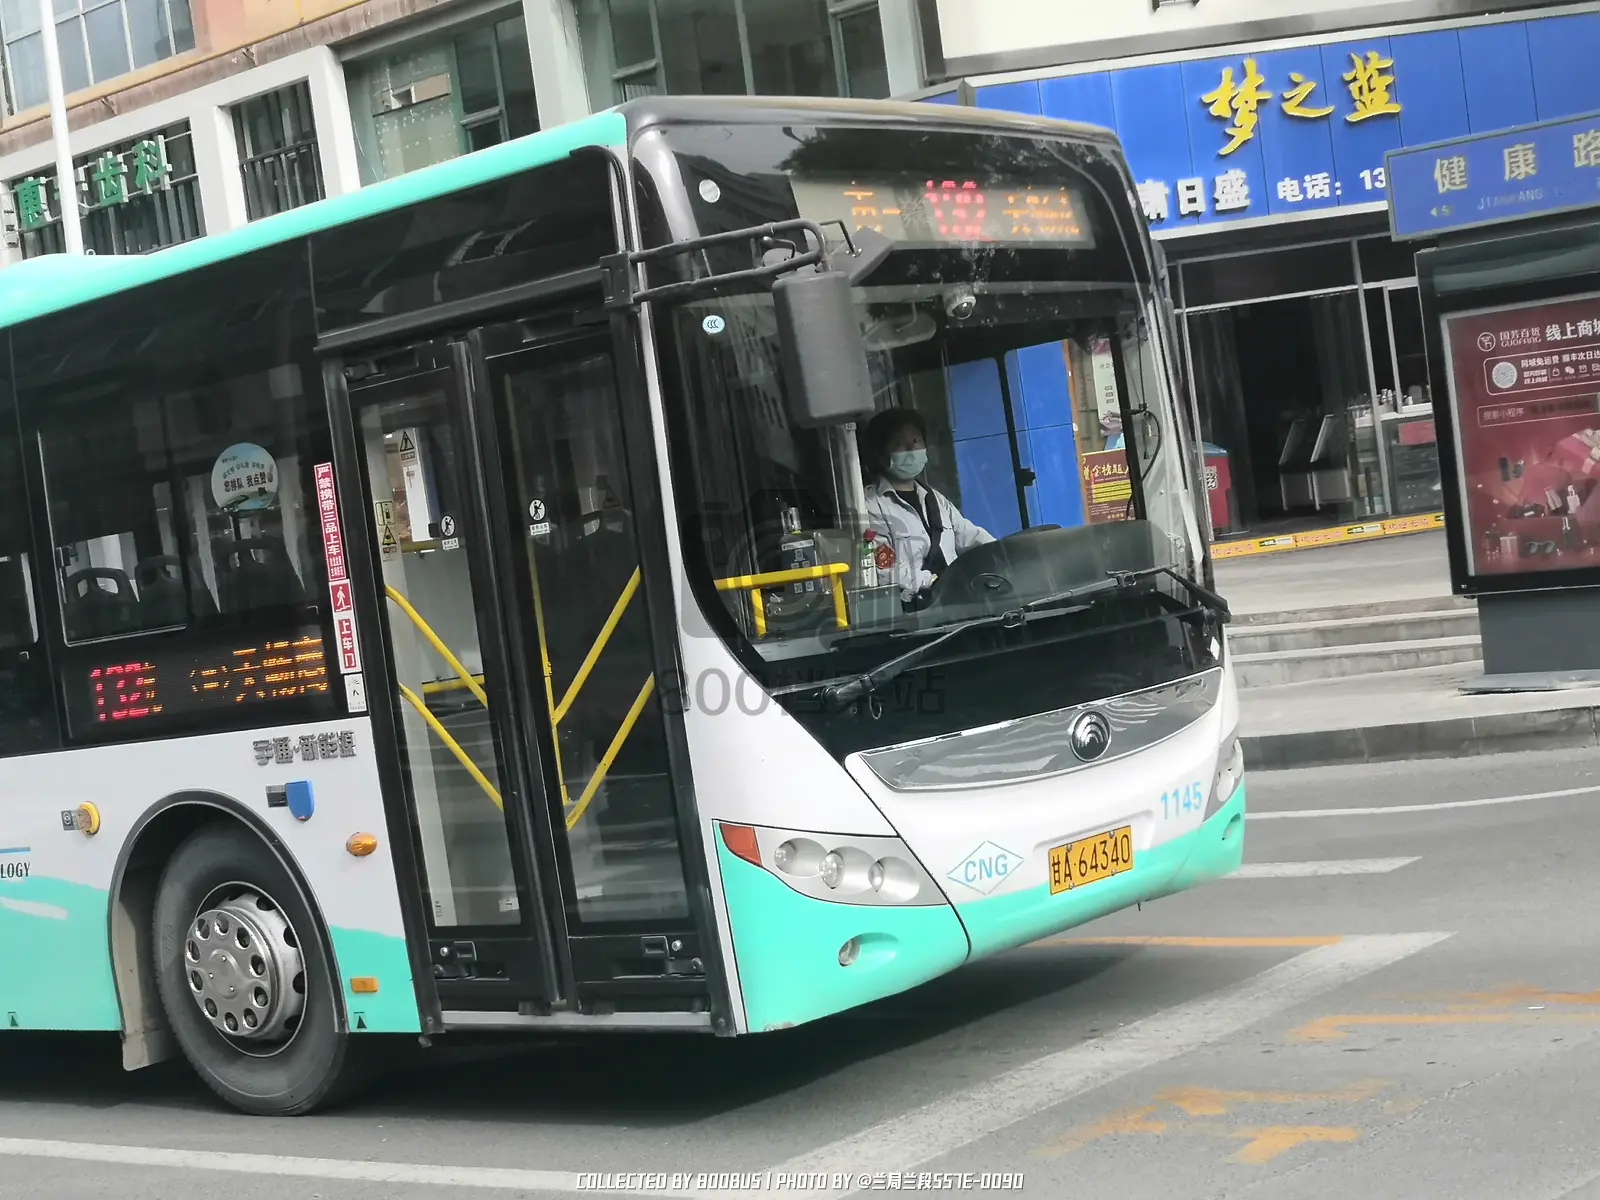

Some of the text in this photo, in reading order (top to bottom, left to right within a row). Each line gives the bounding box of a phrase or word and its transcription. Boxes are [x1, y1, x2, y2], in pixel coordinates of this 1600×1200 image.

[1200, 51, 1401, 156] 梦之蓝
[14, 134, 173, 230] 惠齿科
[1433, 129, 1600, 194] 健康路
[1092, 462, 1129, 476] 金榜题
[1160, 782, 1202, 820] 1145
[964, 854, 1008, 883] CNG
